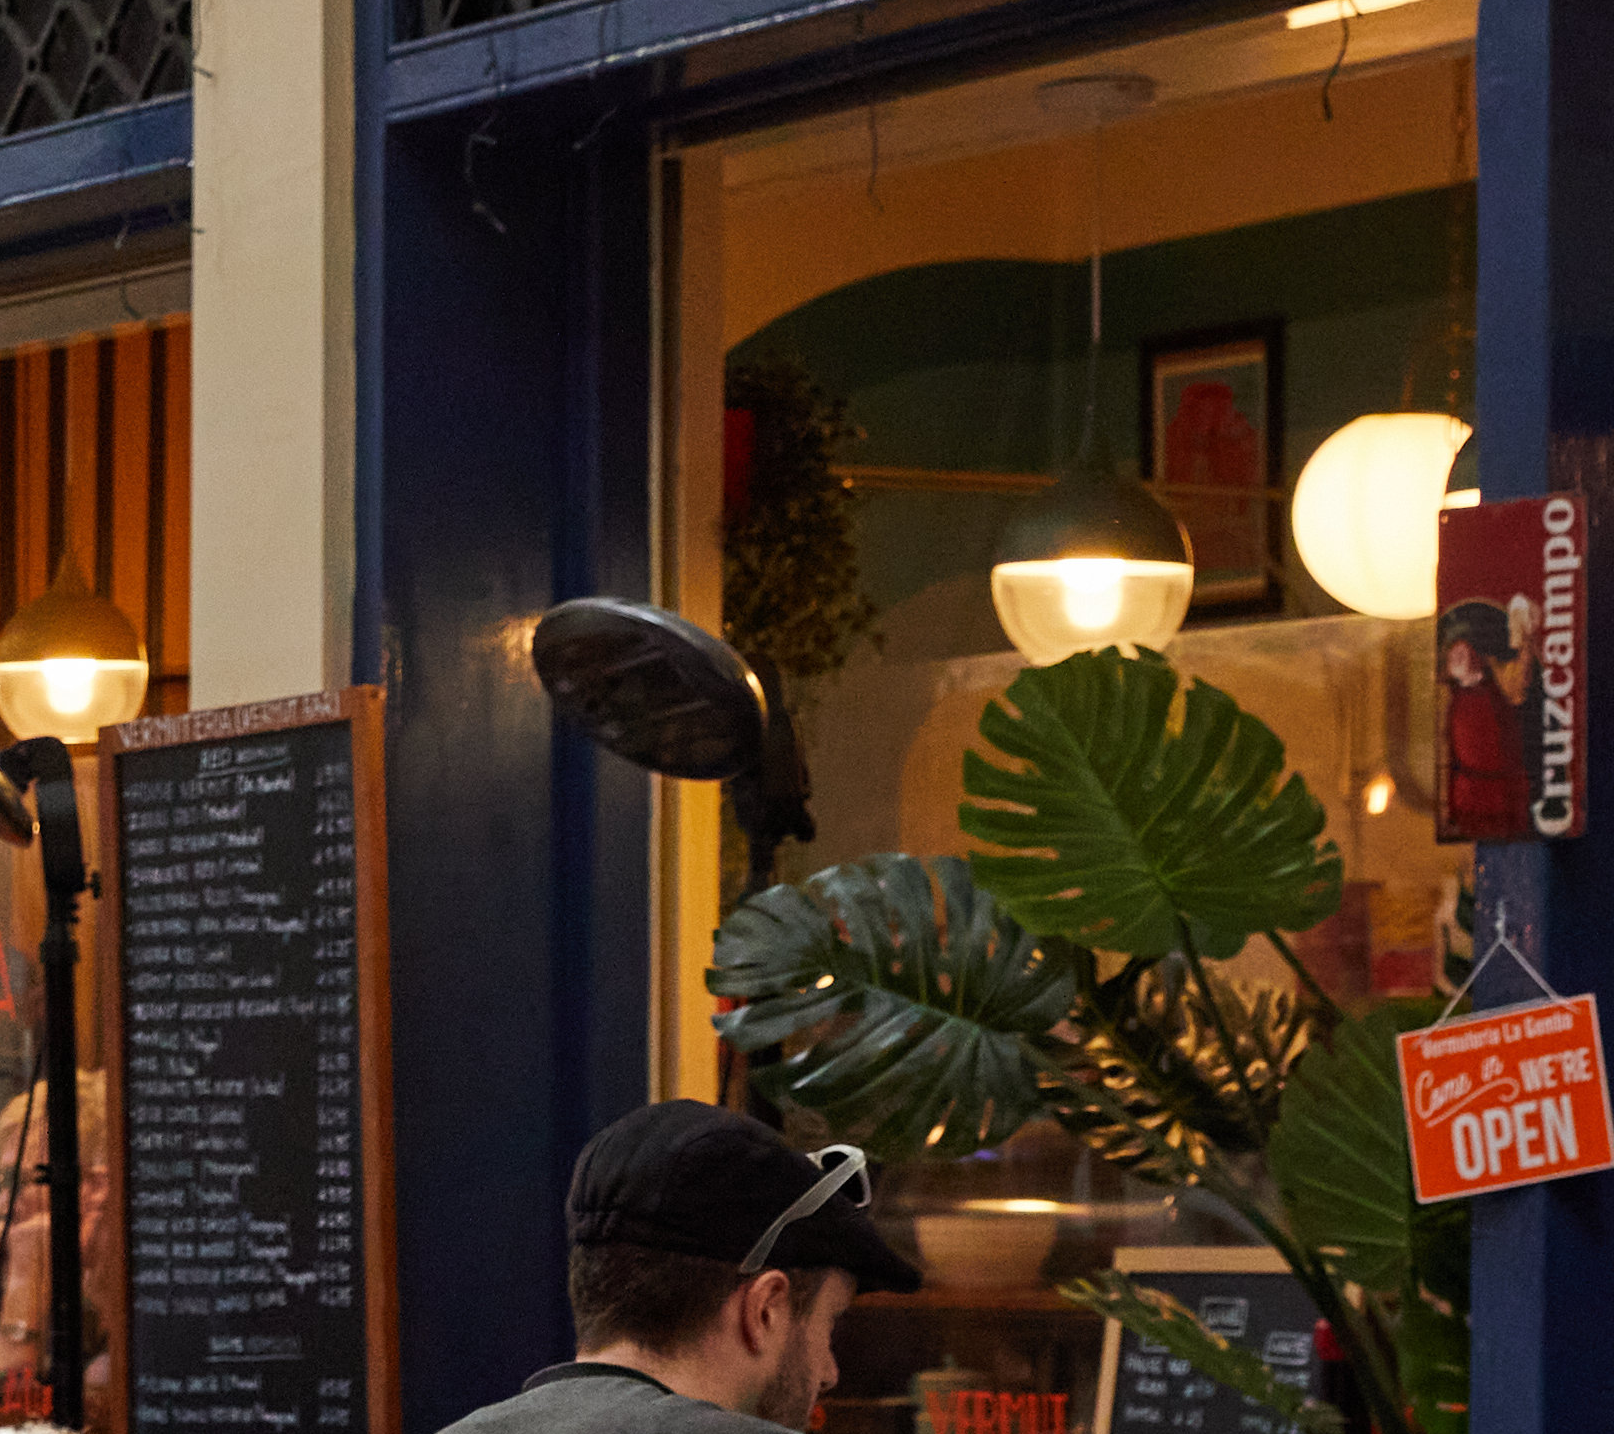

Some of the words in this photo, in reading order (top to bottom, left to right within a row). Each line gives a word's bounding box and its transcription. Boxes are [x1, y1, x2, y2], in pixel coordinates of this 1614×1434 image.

[1532, 497, 1582, 836] Cruzcampo
[1414, 1069, 1473, 1120] Come
[1518, 1047, 1594, 1093] WE'RE
[1450, 1092, 1580, 1181] OPEN
